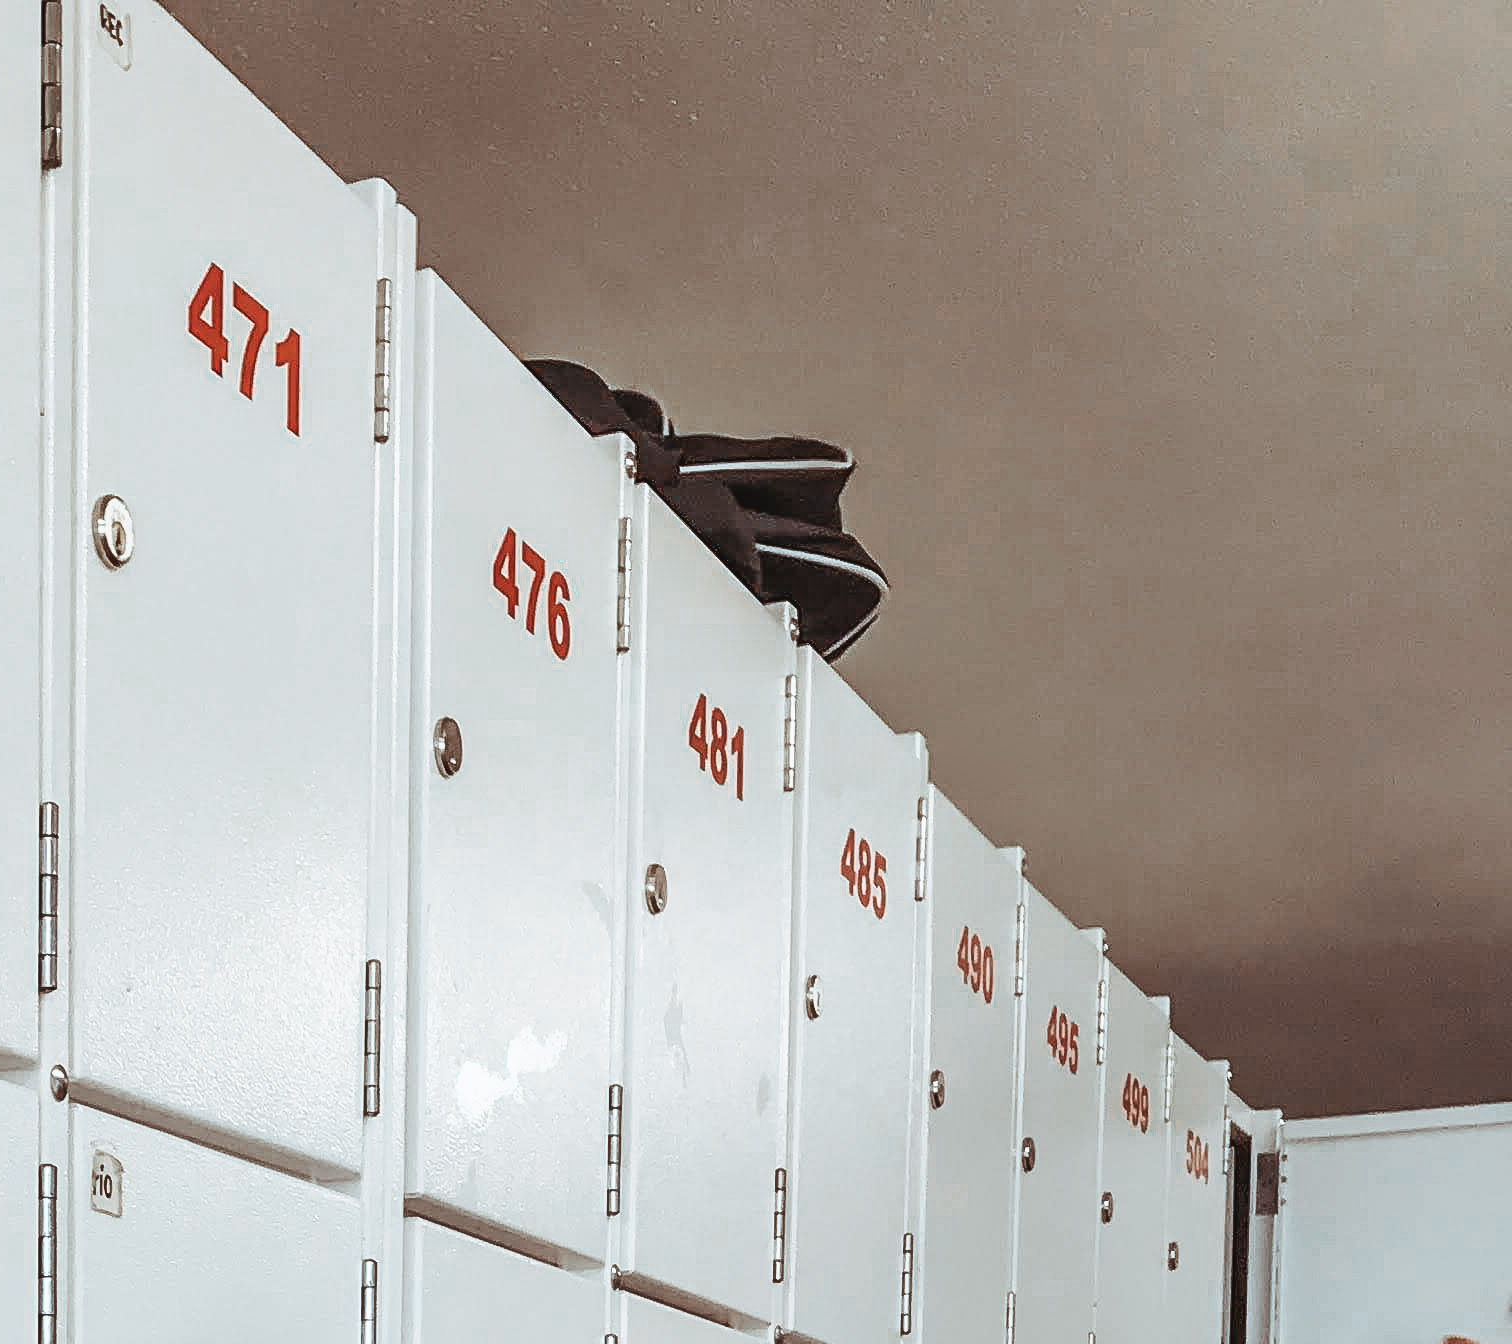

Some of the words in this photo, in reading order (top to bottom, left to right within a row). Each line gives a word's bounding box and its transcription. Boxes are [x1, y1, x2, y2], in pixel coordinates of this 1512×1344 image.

[188, 263, 300, 437] 471
[493, 528, 570, 660] 476
[689, 694, 744, 801] 481
[841, 828, 886, 920] 485
[958, 926, 993, 1004] 490
[1047, 1006, 1078, 1075] 495
[1123, 1073, 1148, 1134] 499
[1187, 1128, 1208, 1184] 504
